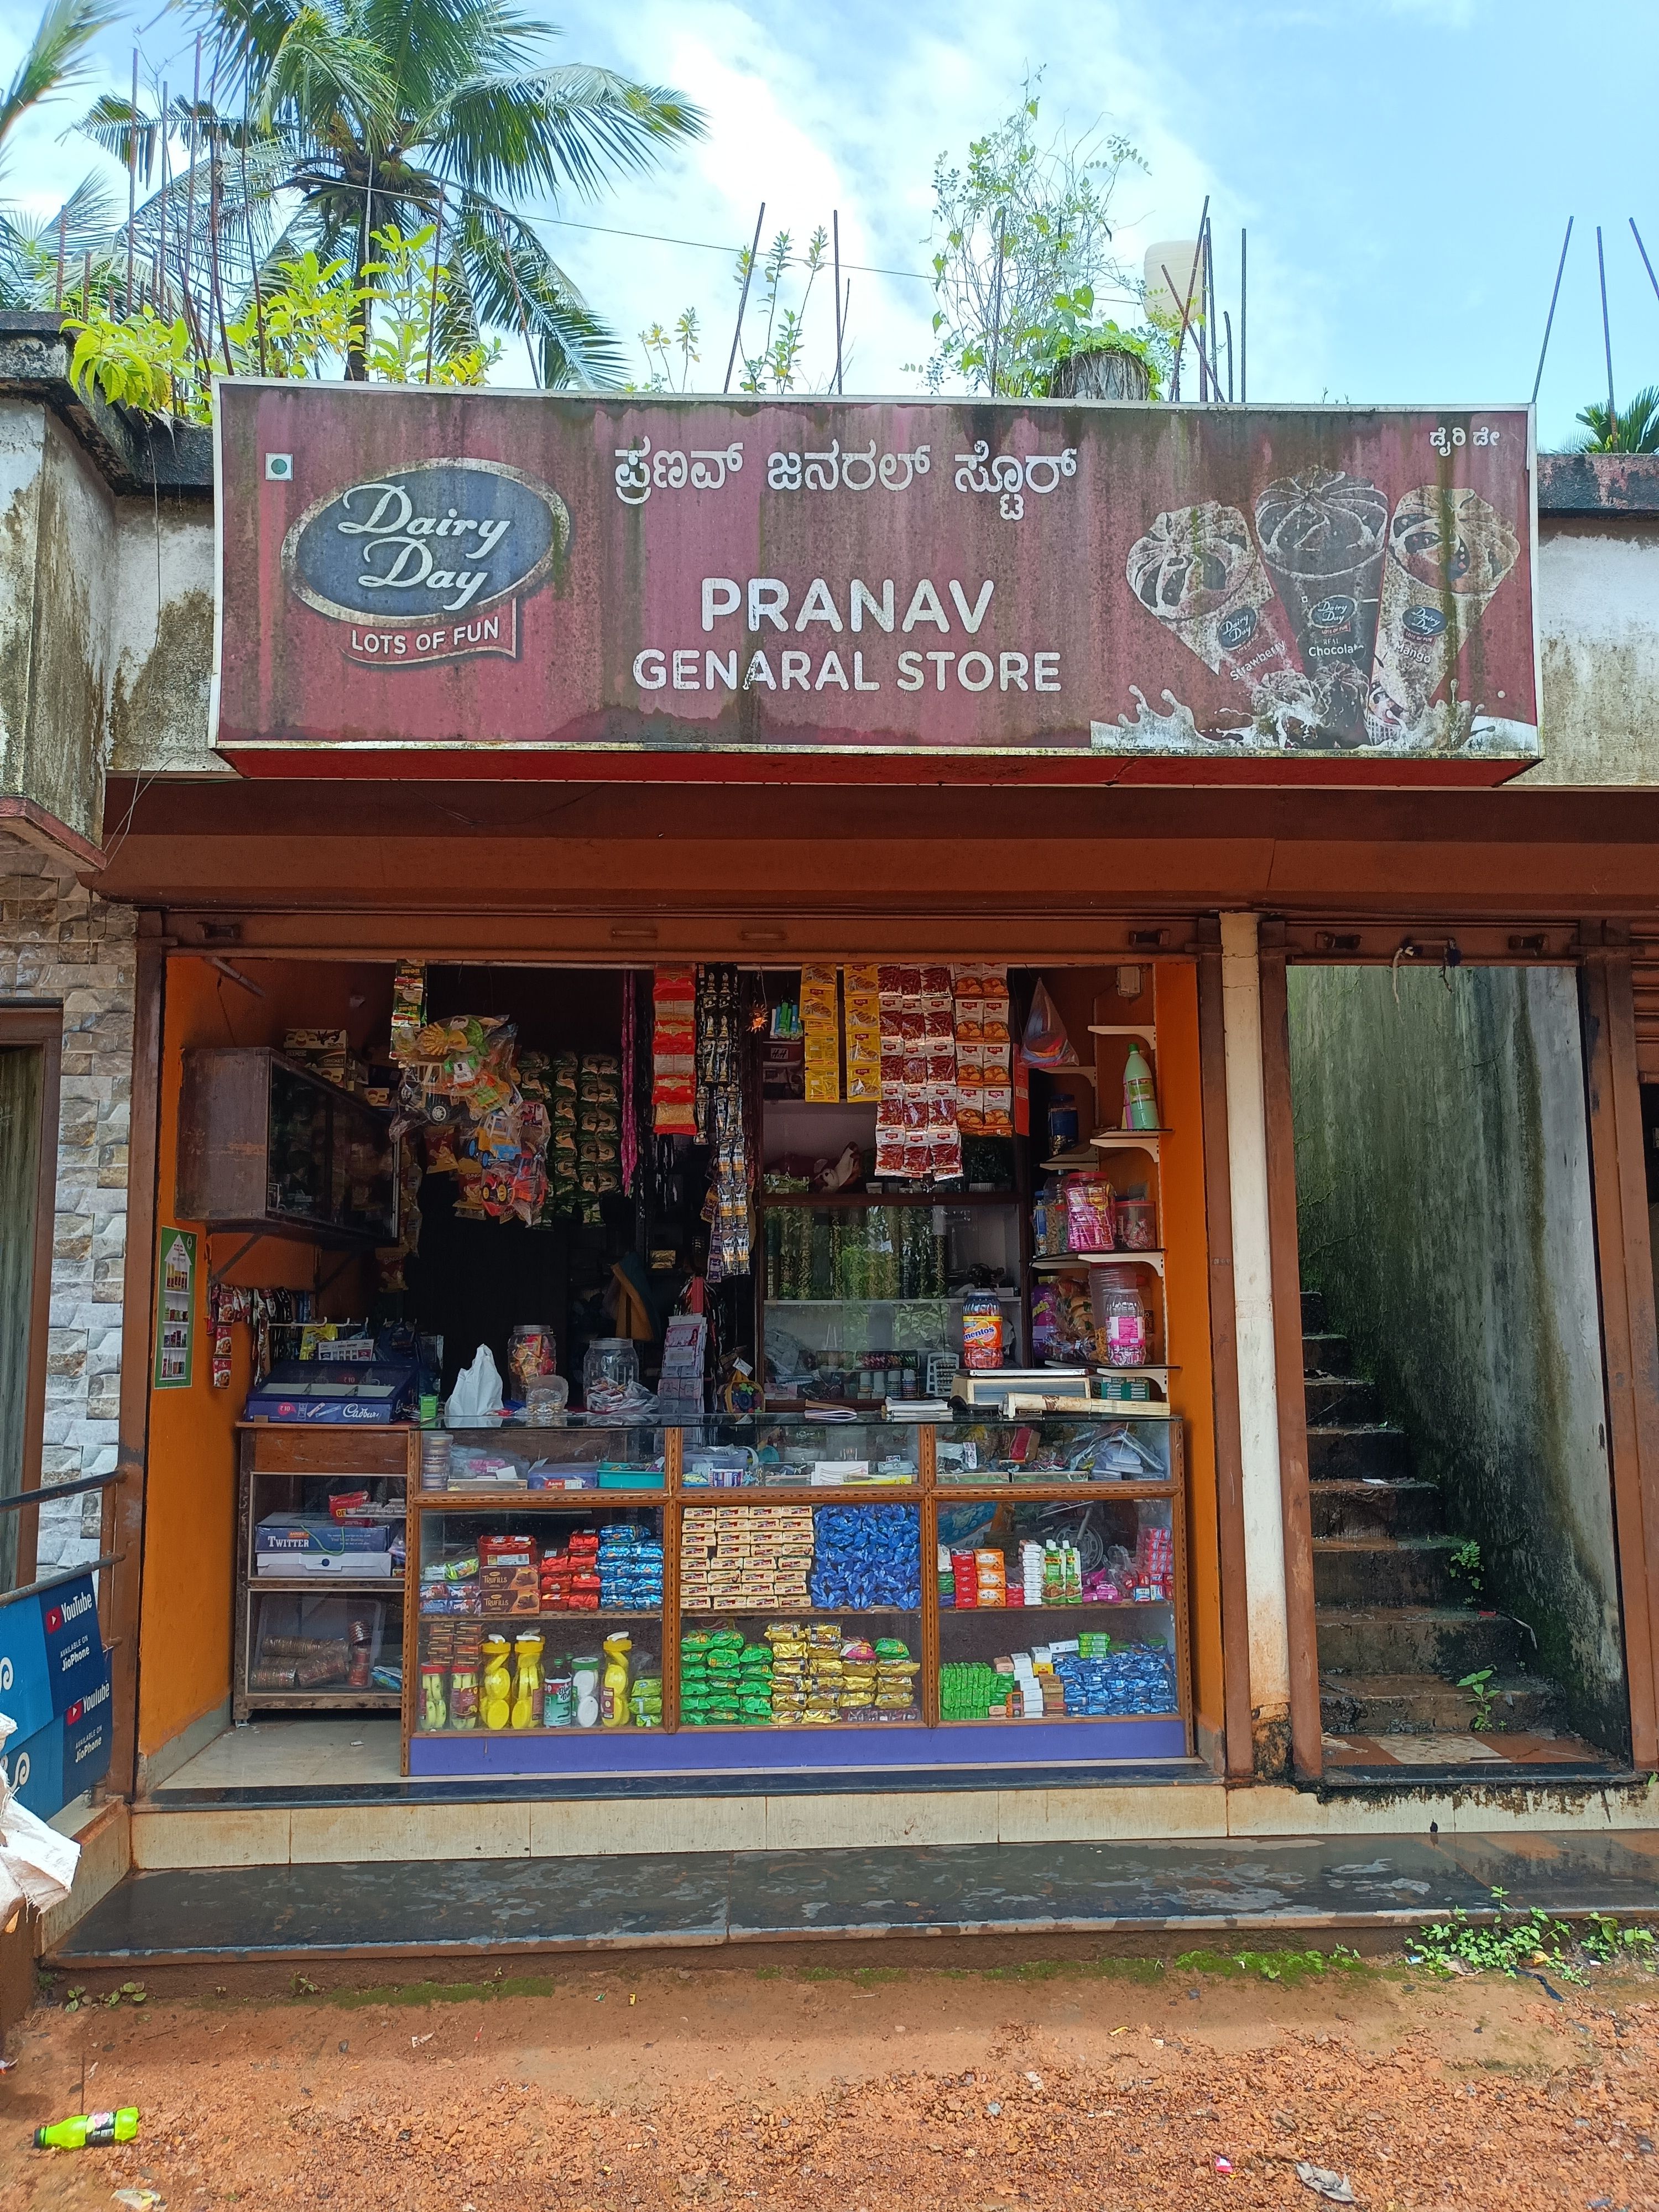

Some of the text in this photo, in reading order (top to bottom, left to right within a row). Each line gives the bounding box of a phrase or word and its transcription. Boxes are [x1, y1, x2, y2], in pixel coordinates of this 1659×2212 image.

[1430, 426, 1500, 457] ಡೈರಿ ಡೇ
[614, 435, 744, 505] ಪ್ರಣವ್
[767, 438, 931, 492] ಜನರಲ್
[337, 483, 511, 560] Dairy
[358, 536, 488, 612] Day
[701, 577, 995, 634] PRANAV
[1317, 601, 1348, 614] Dairy
[1322, 611, 1345, 625] Day
[1411, 606, 1441, 627] Dairy
[352, 616, 500, 655] LOTS OF FUN
[1220, 614, 1249, 636] Dairy
[1228, 625, 1251, 642] Day
[1411, 617, 1434, 635] Day
[1229, 640, 1286, 681] Strawberry
[1394, 640, 1431, 663] Mango
[632, 649, 1062, 693] GENARAL STORE
[964, 1327, 994, 1340] mentos
[267, 1536, 309, 1548] TWITTER
[482, 1575, 508, 1584] TRUFILLS
[61, 1592, 92, 1624] YouTube
[484, 1598, 509, 1606] TRUFILLS
[60, 1634, 88, 1658] AVAILABLE ON
[62, 1646, 90, 1672] JioPhone
[75, 1724, 102, 1750] AVAILABLE ON
[75, 1736, 102, 1764] JioPhone
